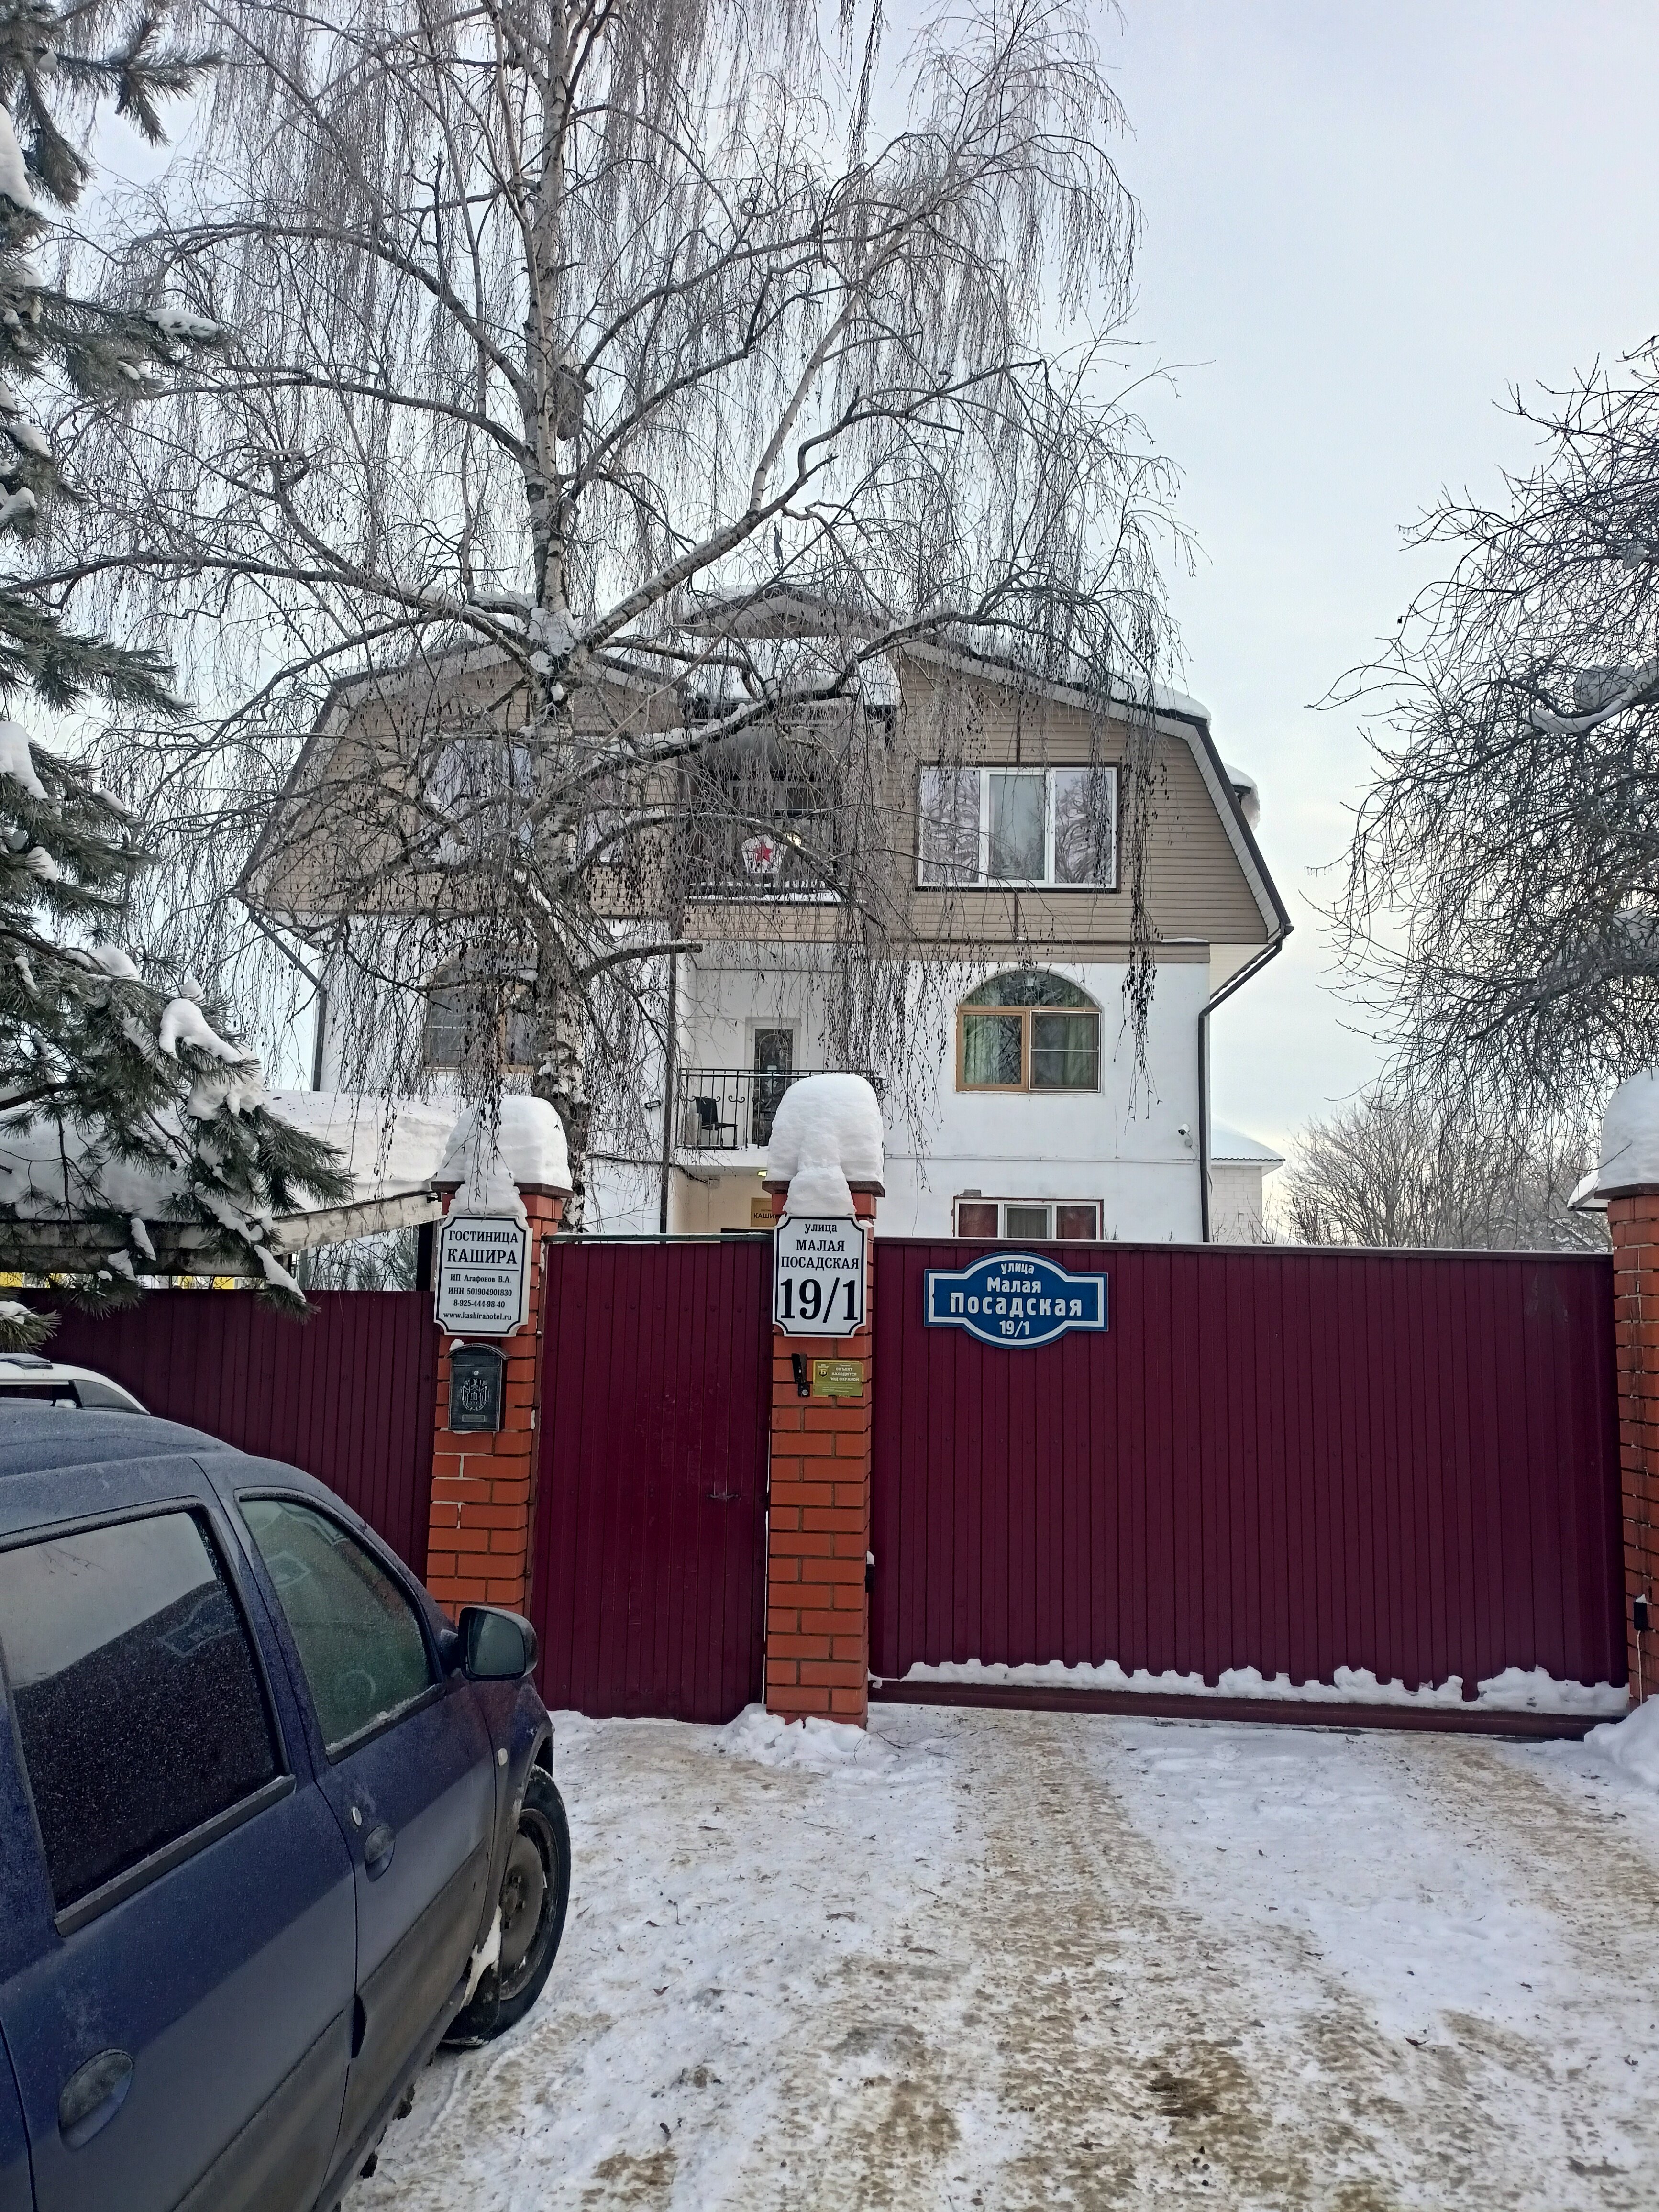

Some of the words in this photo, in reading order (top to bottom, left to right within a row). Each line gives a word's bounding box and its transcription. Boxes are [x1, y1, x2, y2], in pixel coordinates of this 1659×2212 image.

[805, 1223, 837, 1234] улица
[448, 1230, 518, 1245] ГОСТИНИЦА
[796, 1239, 845, 1252] МАЛАЯ
[447, 1248, 517, 1264] КАШИРА
[781, 1256, 859, 1271] ПОСАДСКАЯ
[1001, 1263, 1035, 1274] улица
[464, 1274, 495, 1283] Агафонов
[987, 1277, 1041, 1293] Малая
[467, 1288, 512, 1296] 501904901830
[453, 1299, 505, 1308] 8-925-444-98-40
[780, 1277, 858, 1324] 19/1
[950, 1292, 1082, 1318] Посадская
[443, 1312, 511, 1320] www.kashirahotel.ru
[999, 1320, 1029, 1337] 19/1
